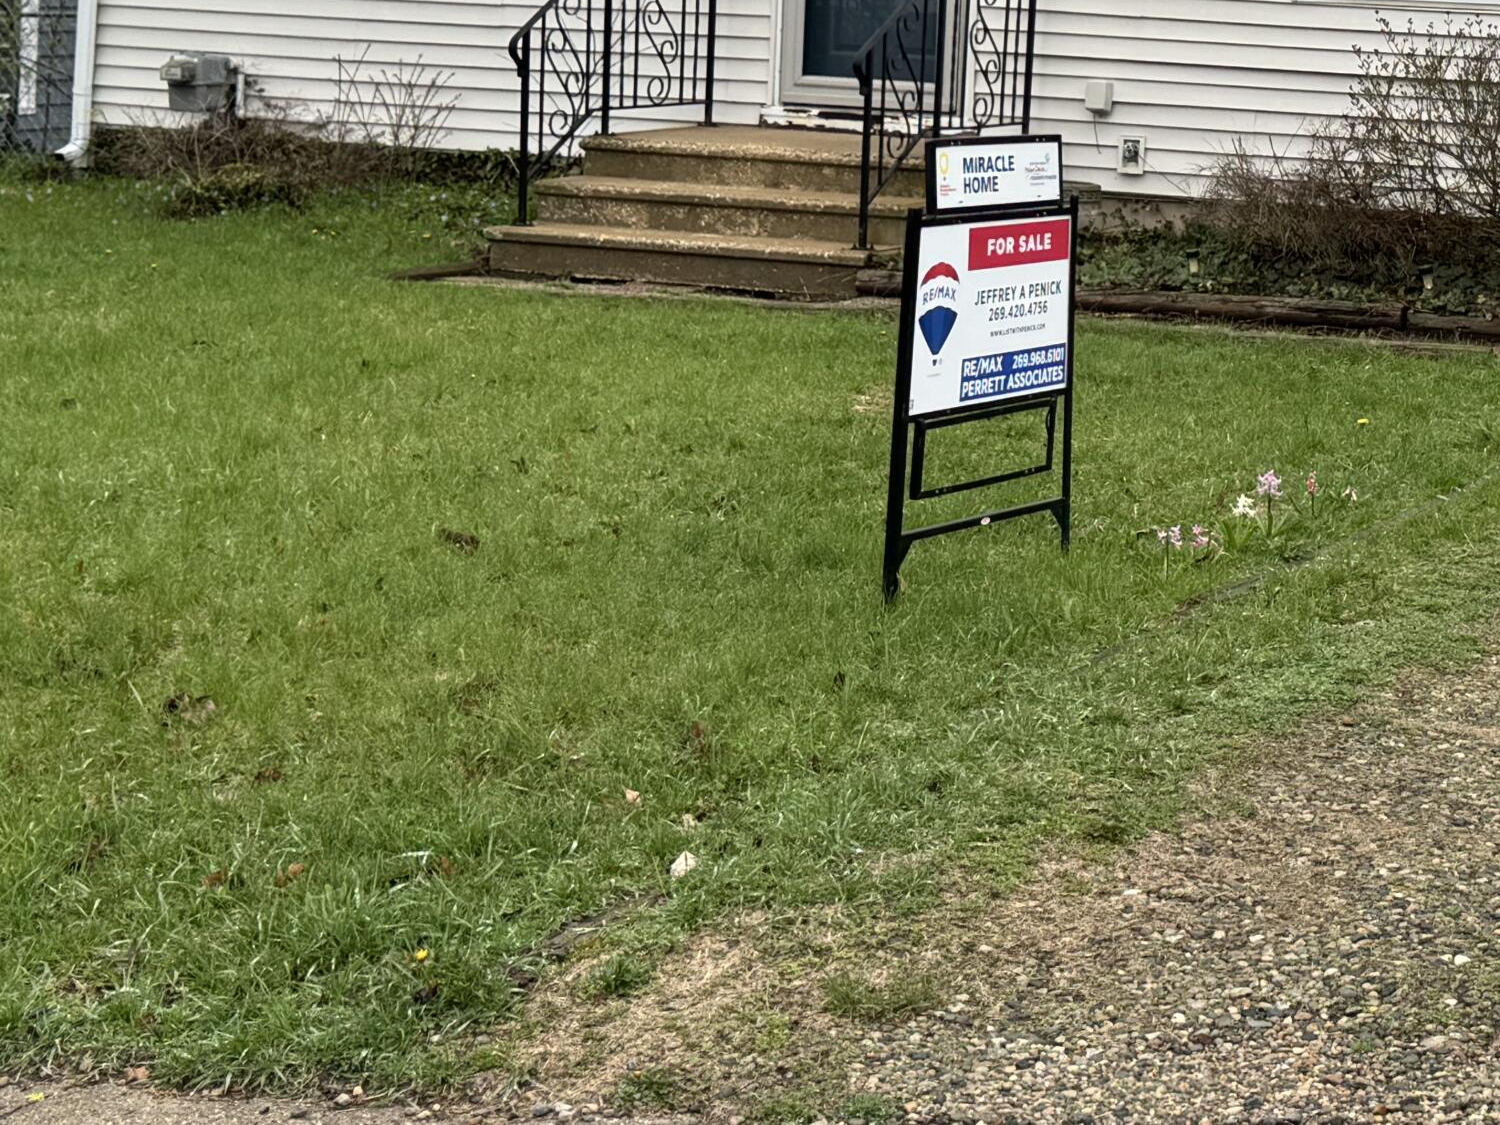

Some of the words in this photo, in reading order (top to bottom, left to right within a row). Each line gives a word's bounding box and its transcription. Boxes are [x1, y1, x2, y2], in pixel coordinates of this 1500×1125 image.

[962, 155, 1015, 174] MIRACLE
[963, 176, 999, 194] HOME
[987, 236, 1015, 256] FOR
[1018, 232, 1052, 253] SALE
[922, 285, 957, 305] RE/MAX
[974, 285, 1017, 306] JEFFREY
[1019, 285, 1026, 300] A
[1029, 279, 1062, 298] PENICK
[988, 300, 1048, 322] 269.420.4756
[963, 355, 1004, 378] RE/MAX
[1012, 347, 1065, 370] 269.968.6101
[961, 375, 1007, 398] PERRETT
[1007, 365, 1064, 390] ASSOCIATES
